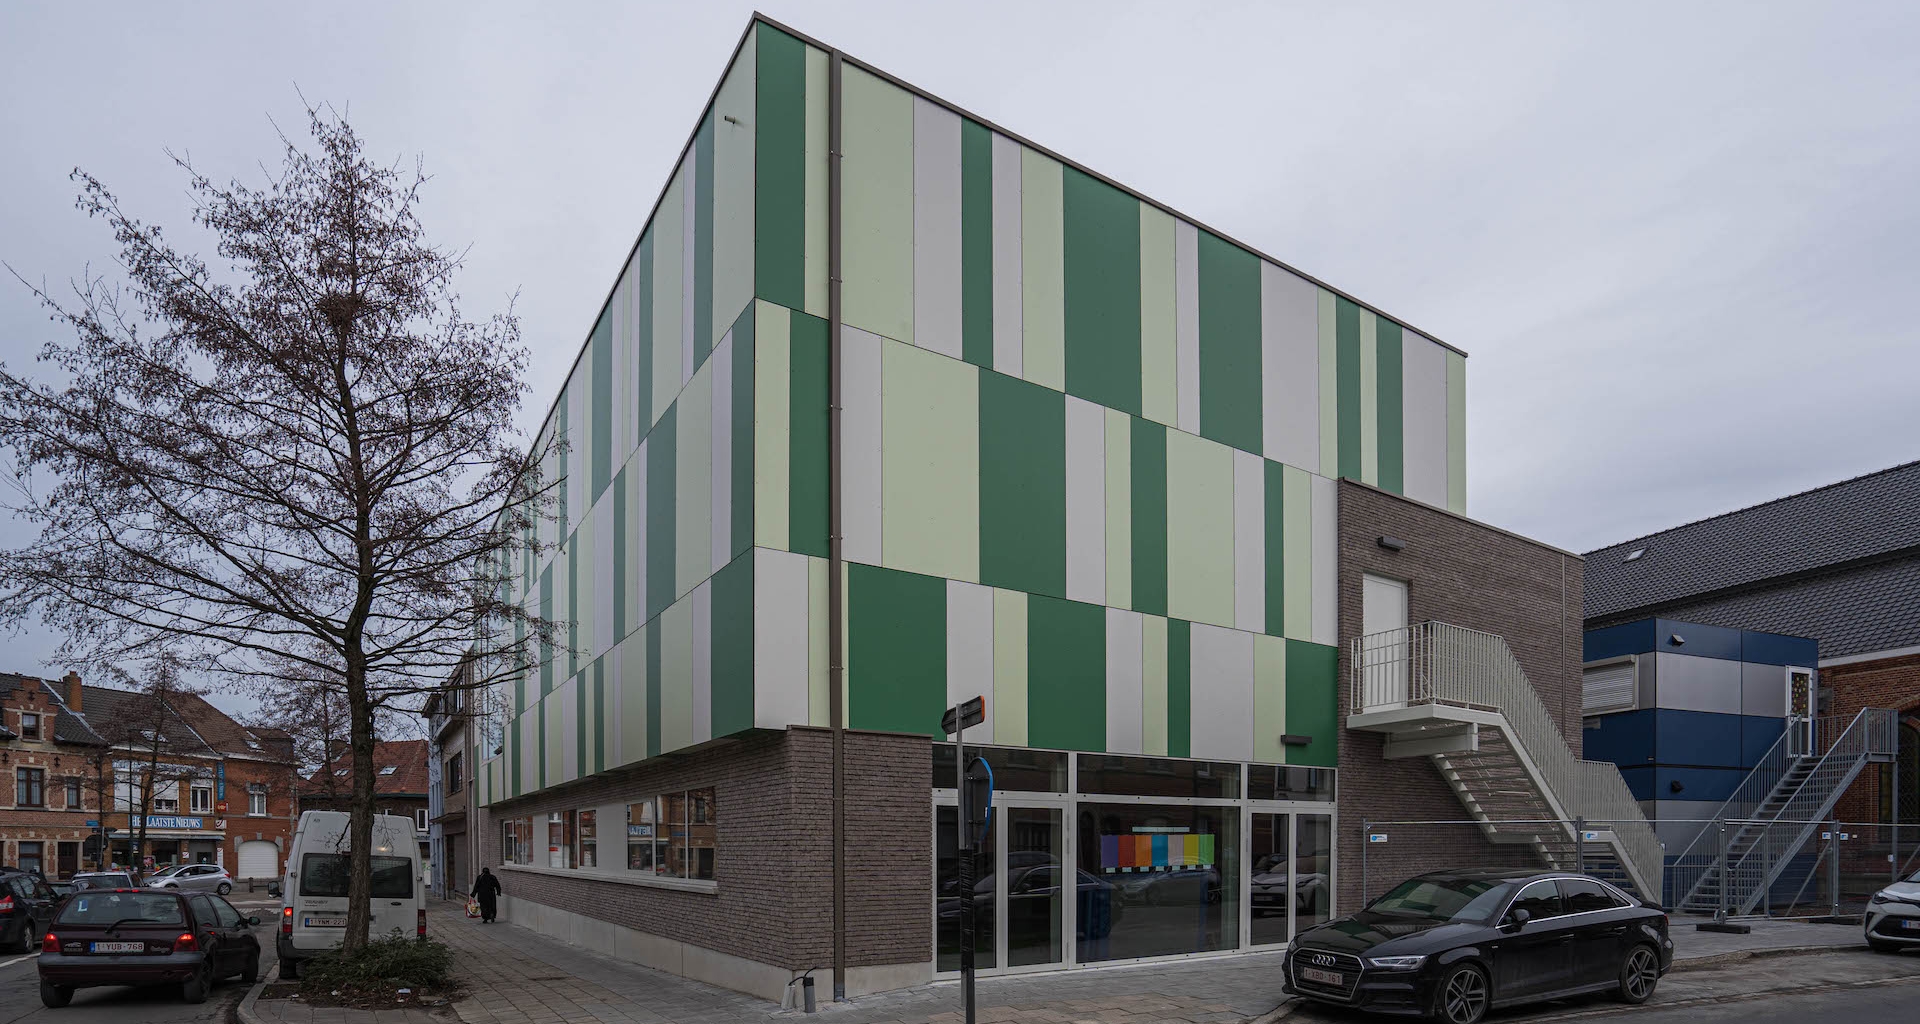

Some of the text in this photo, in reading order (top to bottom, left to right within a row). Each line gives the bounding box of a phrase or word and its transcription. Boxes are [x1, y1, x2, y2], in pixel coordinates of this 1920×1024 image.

[132, 816, 200, 828] HE LAATSTE NIEUWS
